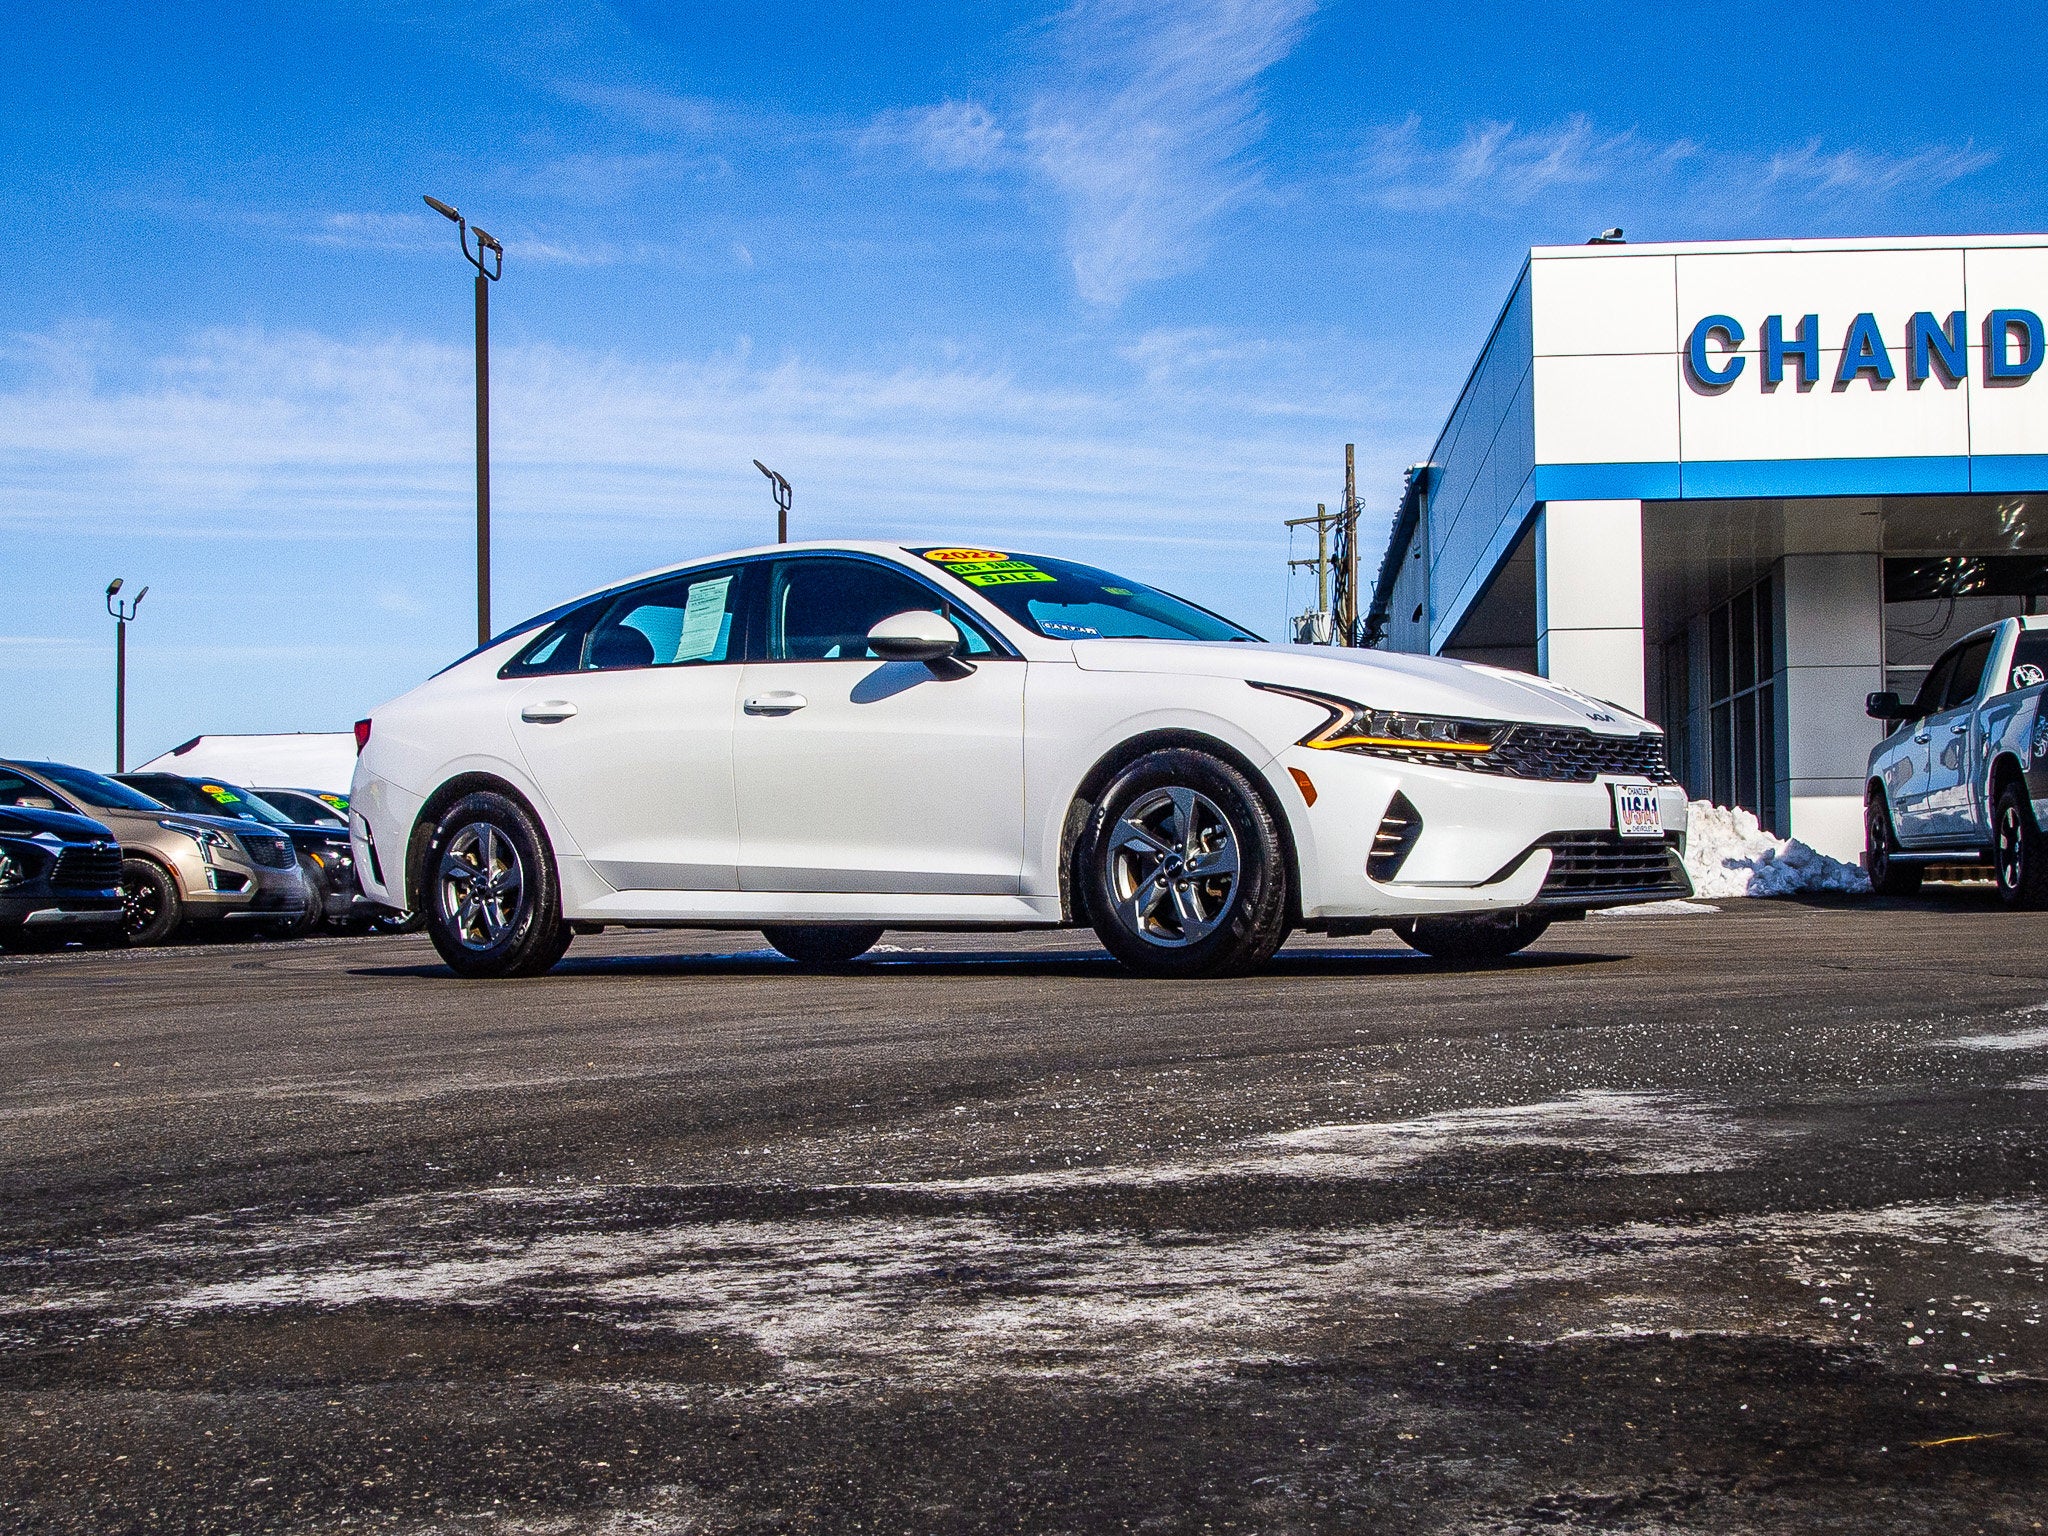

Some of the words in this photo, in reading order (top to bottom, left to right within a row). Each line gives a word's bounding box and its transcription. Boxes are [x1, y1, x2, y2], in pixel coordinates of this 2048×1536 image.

[1687, 309, 2046, 390] CHAND
[935, 550, 1002, 560] 2022
[980, 573, 1041, 583] SALE
[1621, 796, 1660, 825] USA1
